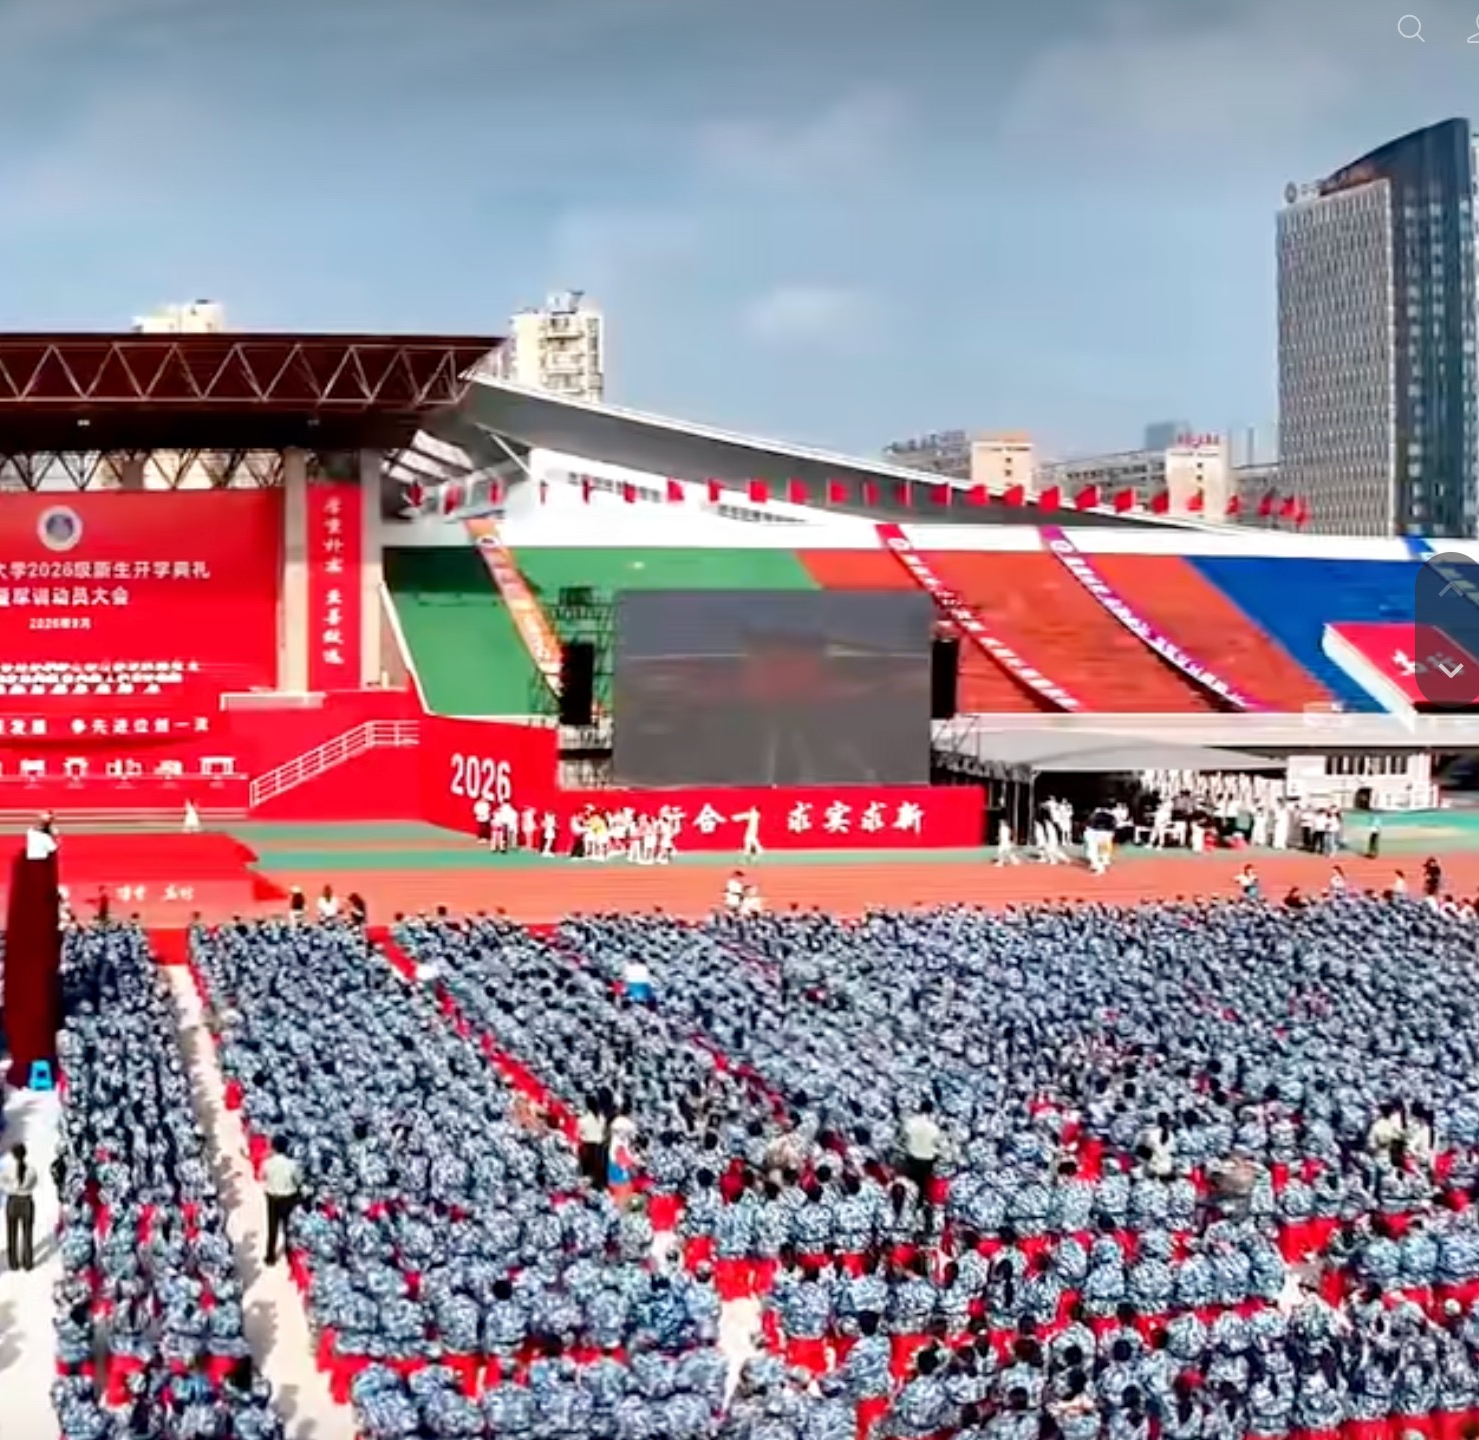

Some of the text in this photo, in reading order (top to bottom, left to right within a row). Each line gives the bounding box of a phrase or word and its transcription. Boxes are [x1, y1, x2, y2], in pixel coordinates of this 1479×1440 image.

[450, 752, 511, 802] 2026
[786, 800, 924, 834] 求实求新
